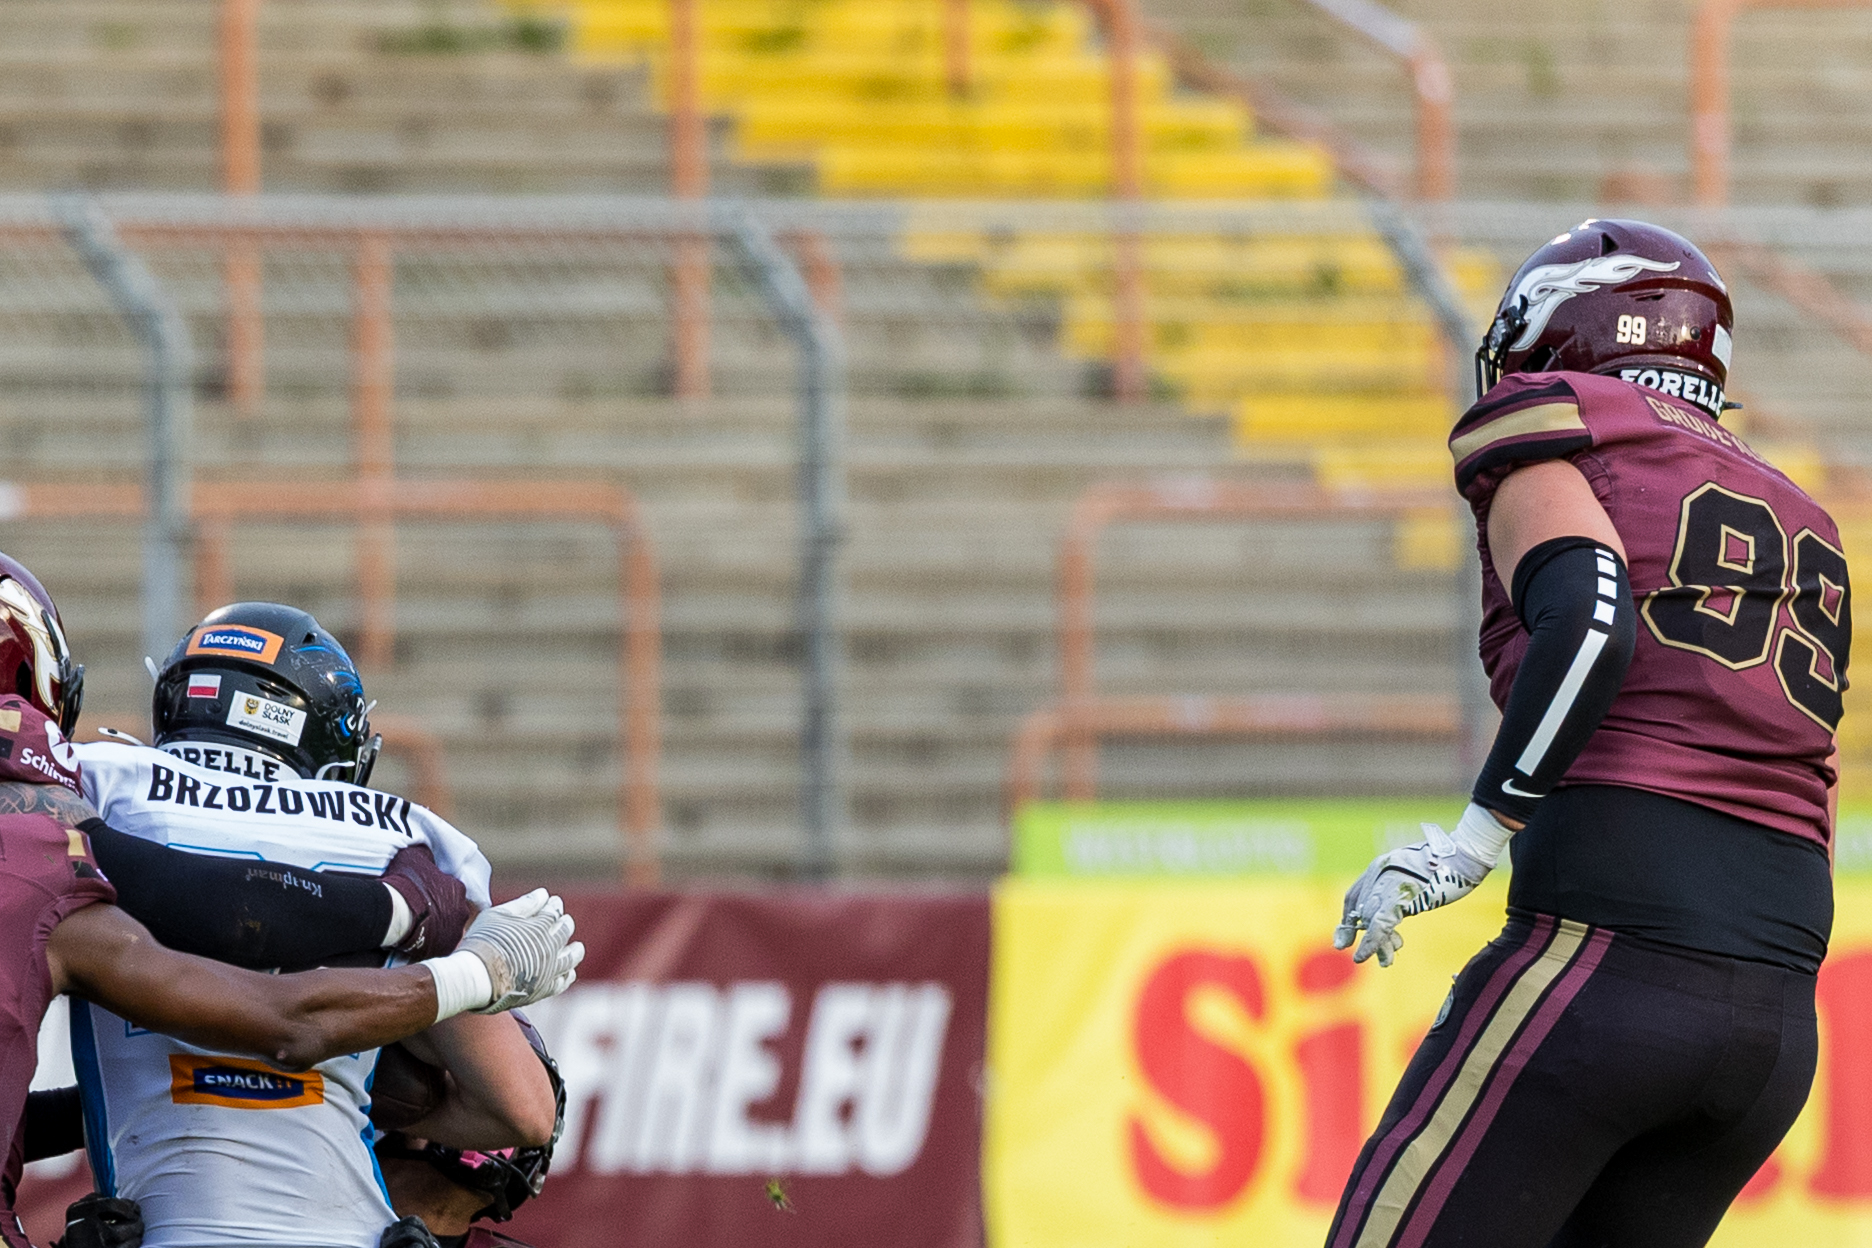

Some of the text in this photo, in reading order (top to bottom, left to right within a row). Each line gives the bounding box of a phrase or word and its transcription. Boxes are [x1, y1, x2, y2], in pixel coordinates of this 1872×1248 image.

[1616, 314, 1647, 346] 99
[1639, 480, 1853, 735] 99
[264, 702, 296, 719] DOLNY
[146, 762, 414, 839] BRZOZOWSKI
